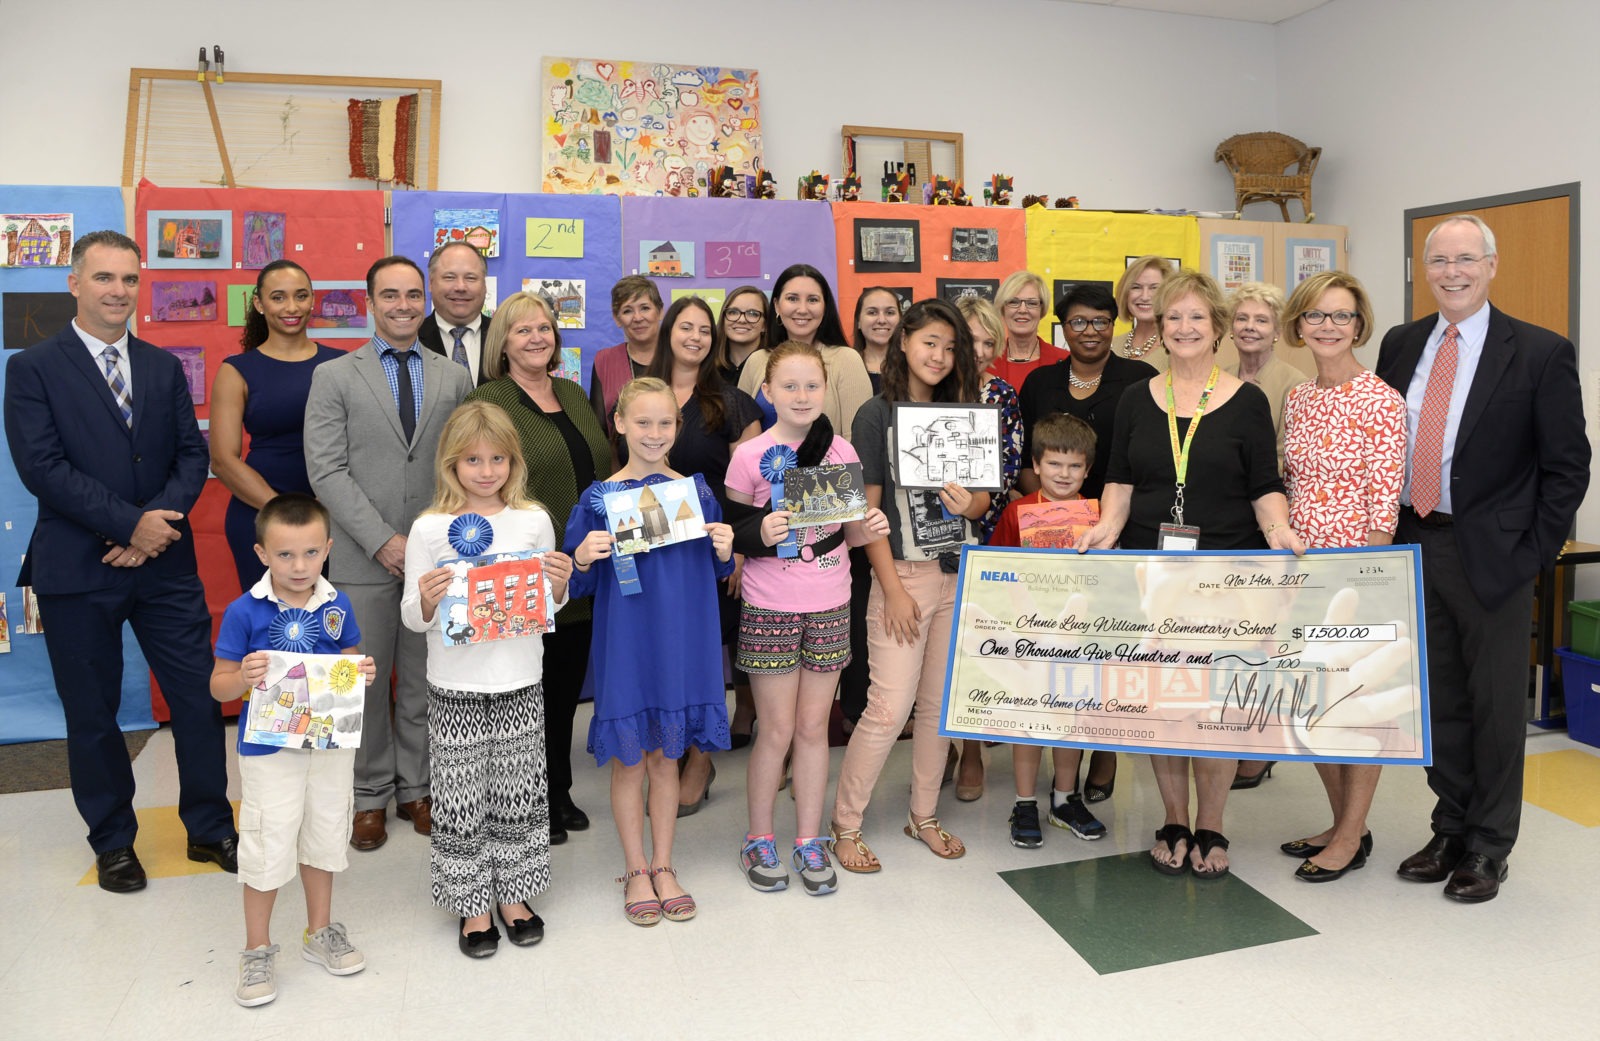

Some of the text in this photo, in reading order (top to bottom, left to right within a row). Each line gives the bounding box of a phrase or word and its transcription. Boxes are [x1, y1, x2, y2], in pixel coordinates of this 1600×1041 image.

[533, 218, 576, 250] 2nd
[714, 243, 759, 275] 3rd
[24, 303, 49, 339] K
[1224, 574, 1247, 587] Nov
[1278, 573, 1310, 586] 2017
[1016, 613, 1278, 639] Annie Lucy Williams Elementary School
[1291, 626, 1303, 640] $
[979, 638, 1213, 665] One Thousand Five Hundred and
[967, 707, 993, 715] MEMO
[968, 689, 1149, 714] My Favorite Home Art Contest
[1197, 723, 1249, 732] SIGNATURE
